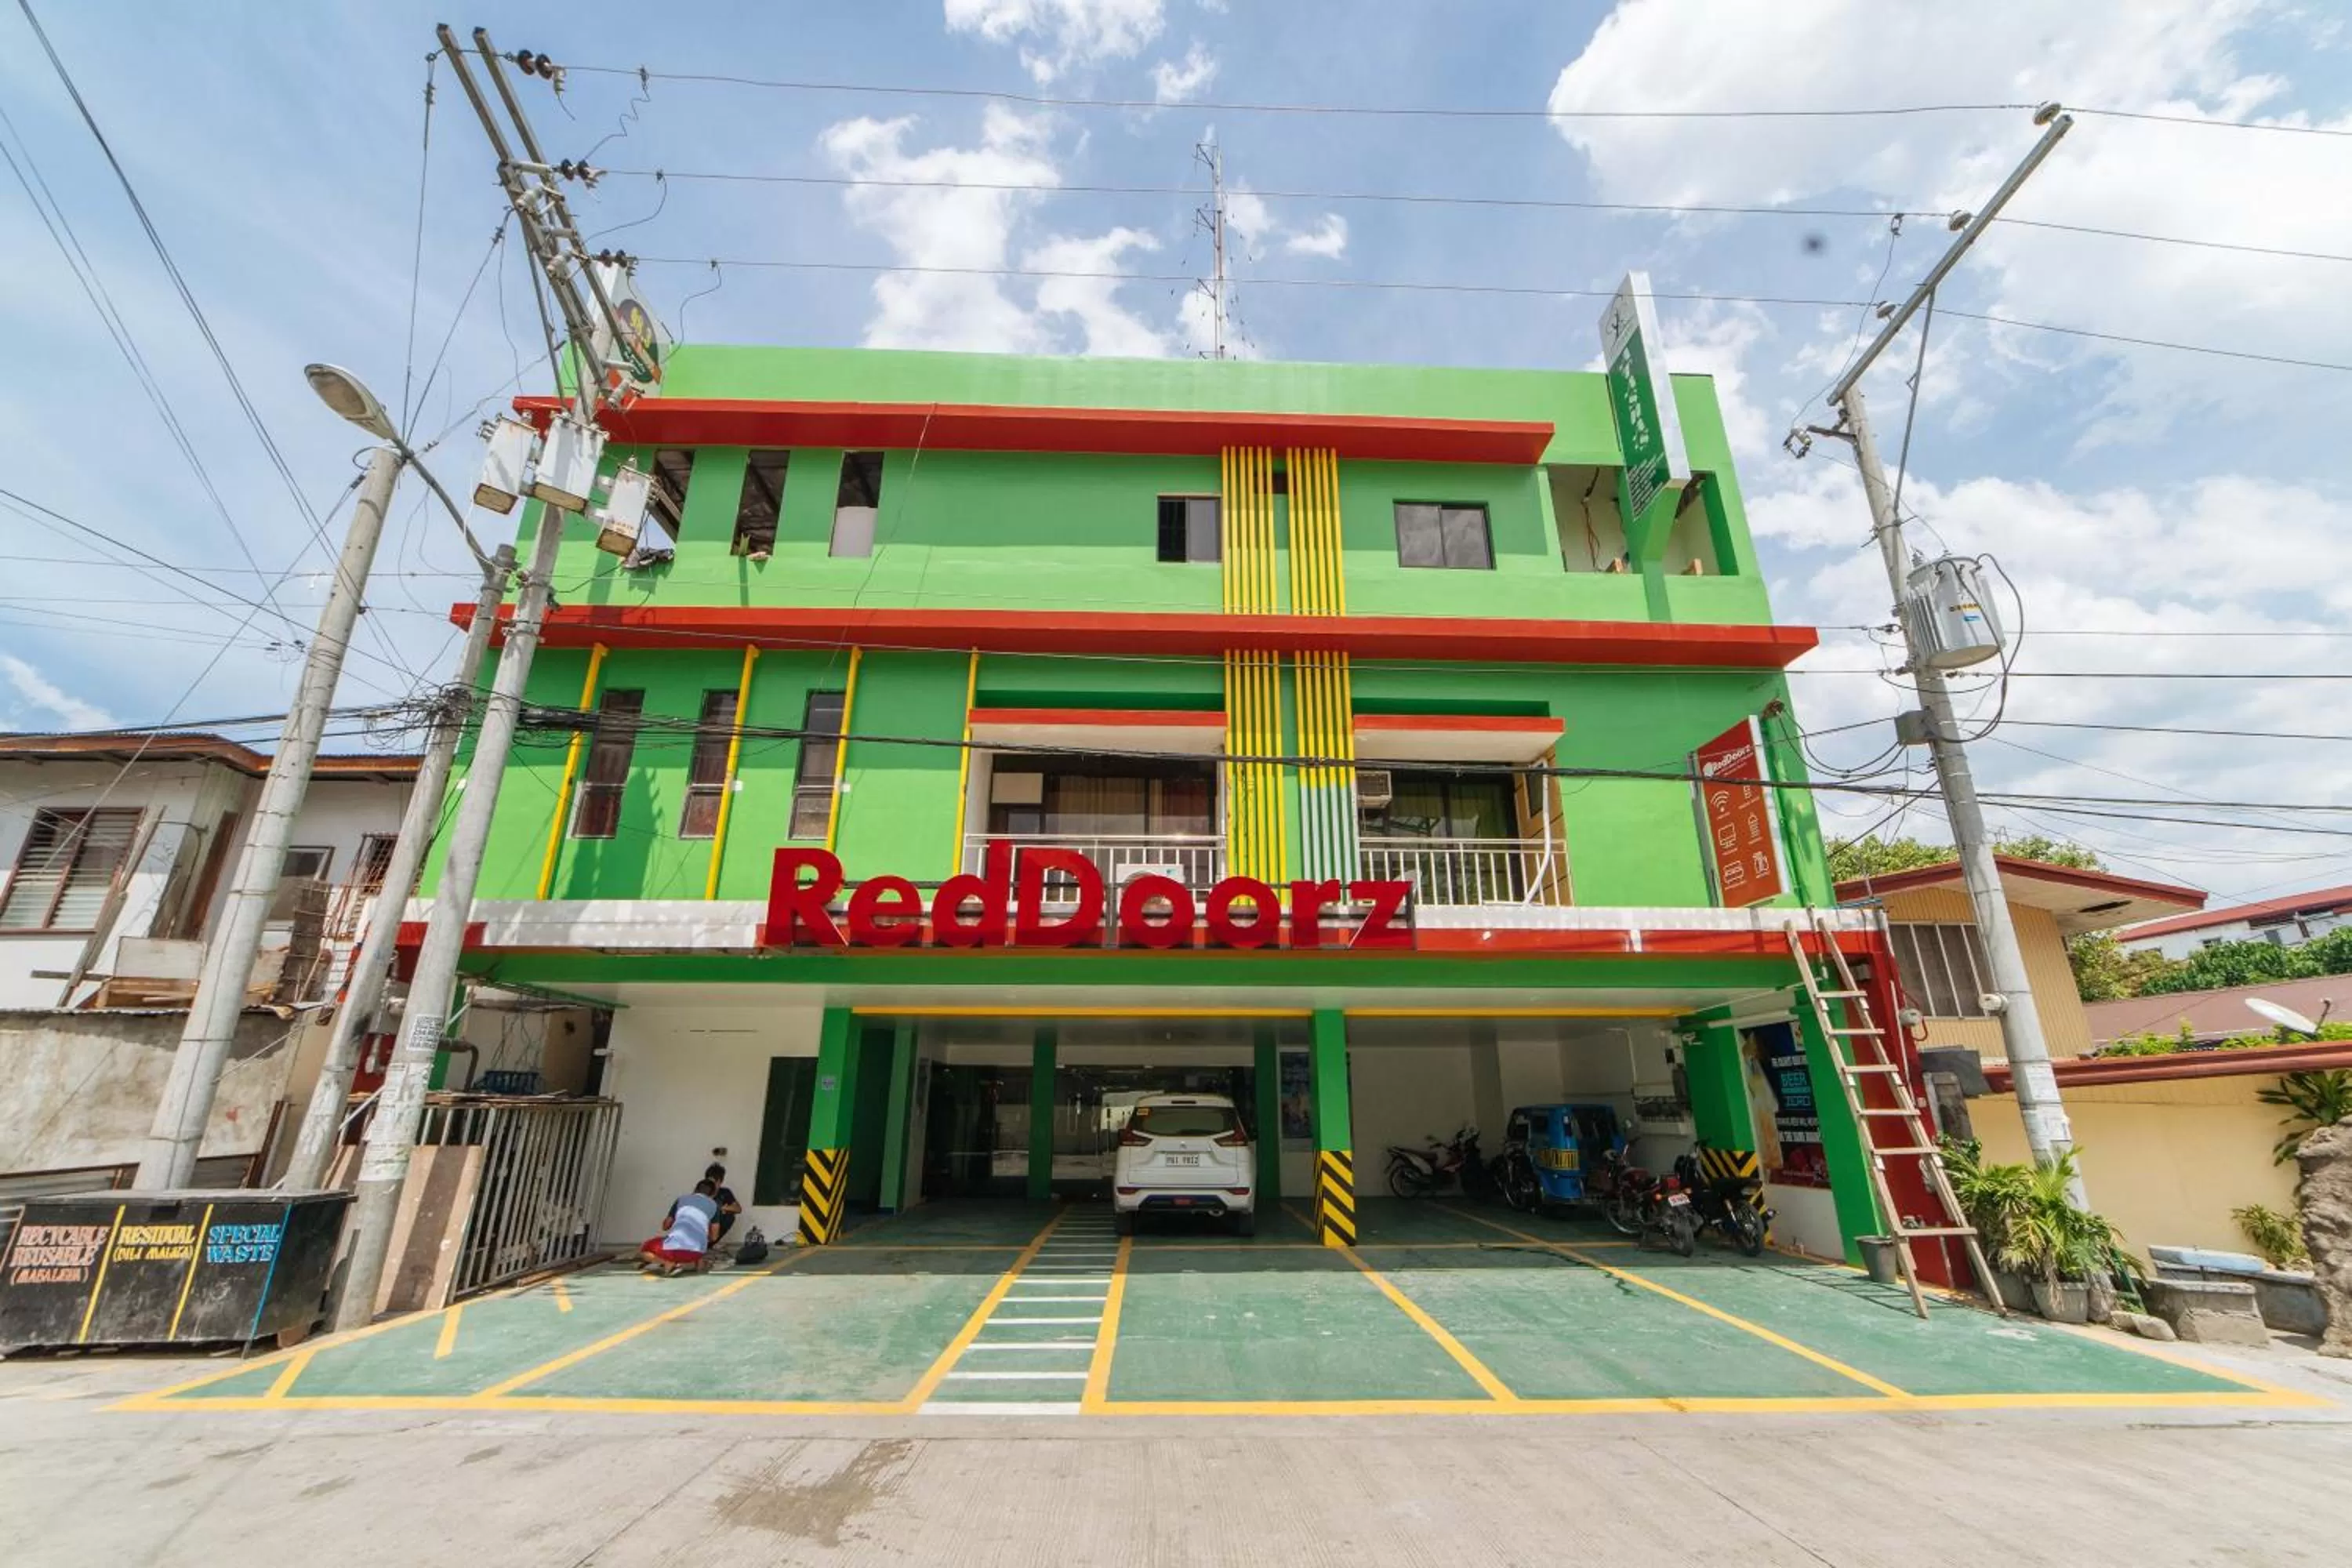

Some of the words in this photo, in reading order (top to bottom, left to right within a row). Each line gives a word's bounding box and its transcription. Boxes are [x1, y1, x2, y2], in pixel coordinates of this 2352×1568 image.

[764, 839, 1414, 949] RedDoorz
[117, 1224, 197, 1245] RESIDUAL
[208, 1224, 280, 1244] SPECIAL
[9, 1245, 100, 1267] REUSABLE
[207, 1244, 274, 1263] WASTE
